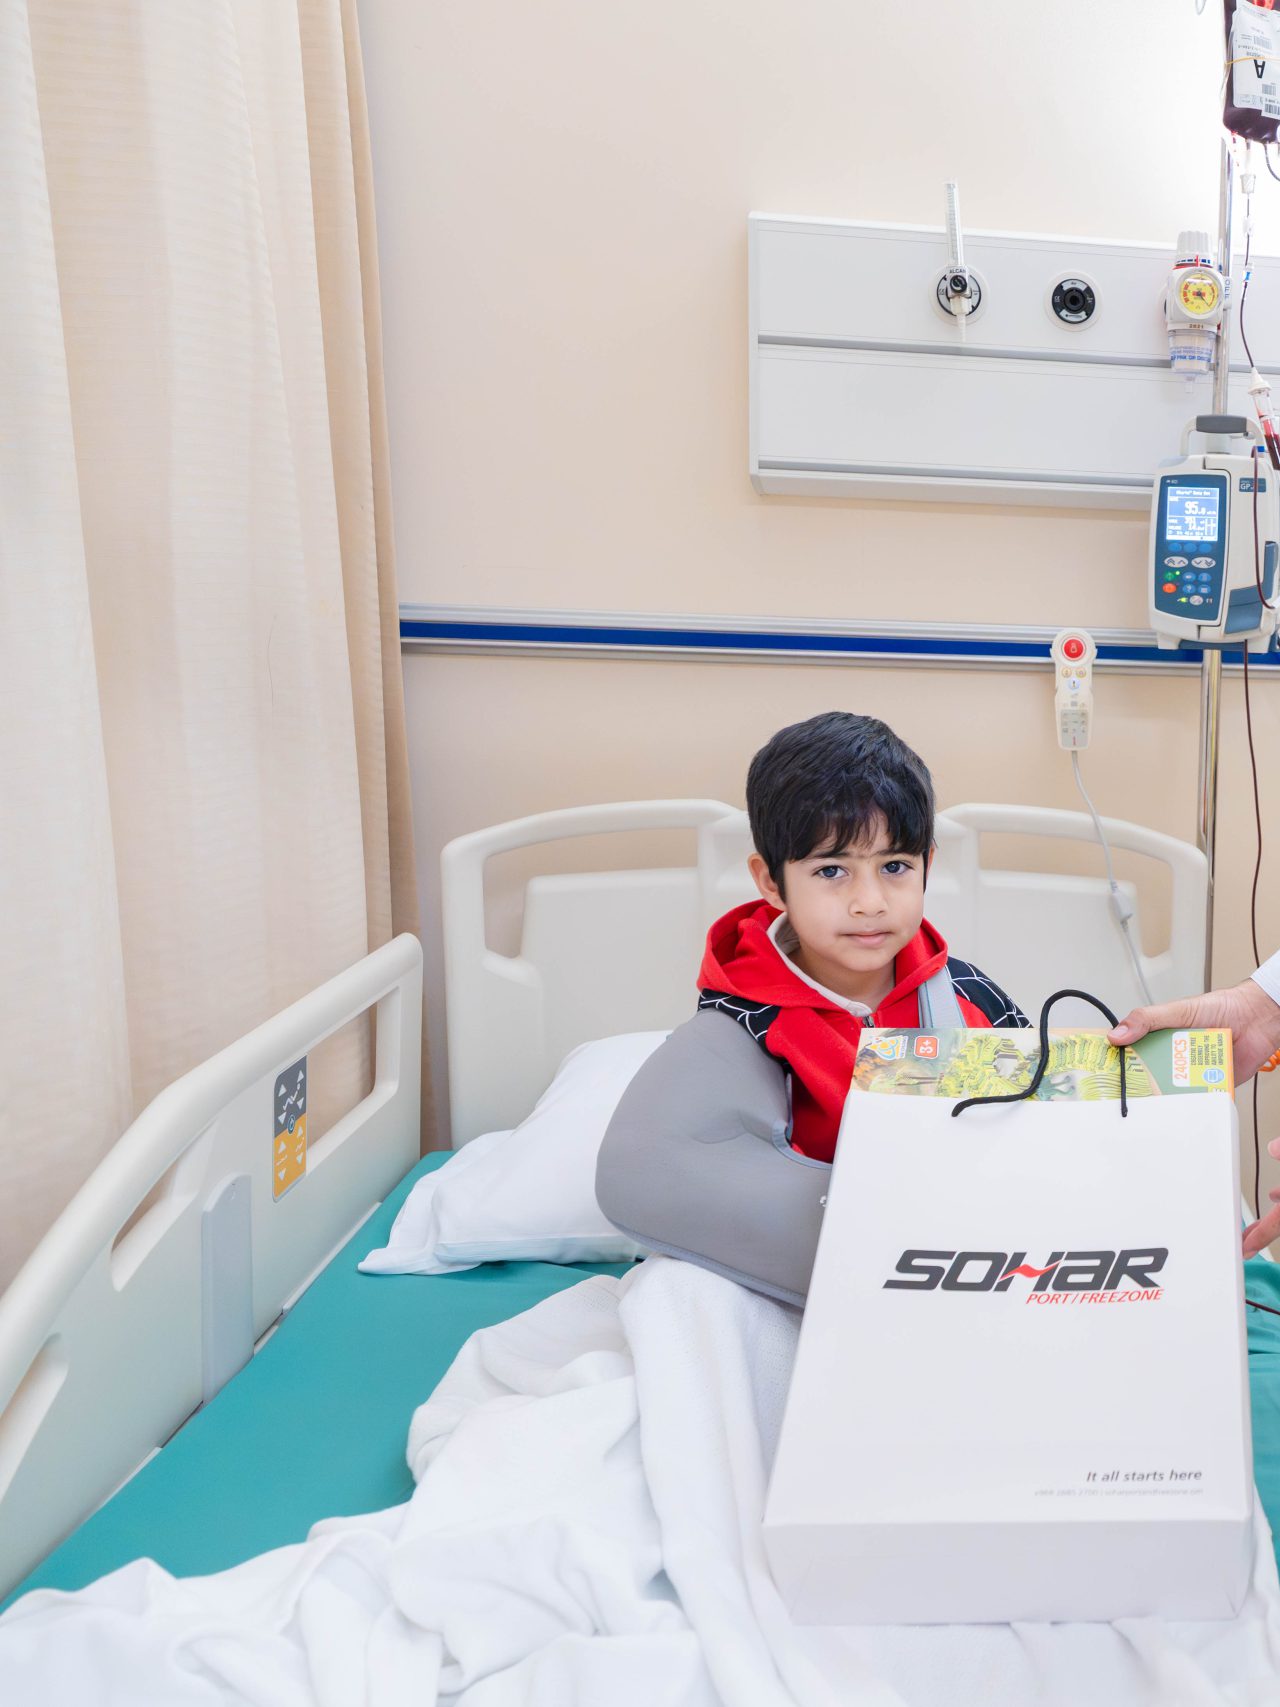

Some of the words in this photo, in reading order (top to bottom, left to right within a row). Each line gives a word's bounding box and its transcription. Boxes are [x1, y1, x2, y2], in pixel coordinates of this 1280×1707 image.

[919, 1040, 934, 1054] 3+
[1174, 1039, 1188, 1080] 240PCS
[1086, 1471, 1097, 1482] It
[1101, 1471, 1120, 1482] all
[1123, 1471, 1165, 1482] starts
[1169, 1469, 1203, 1481] here
